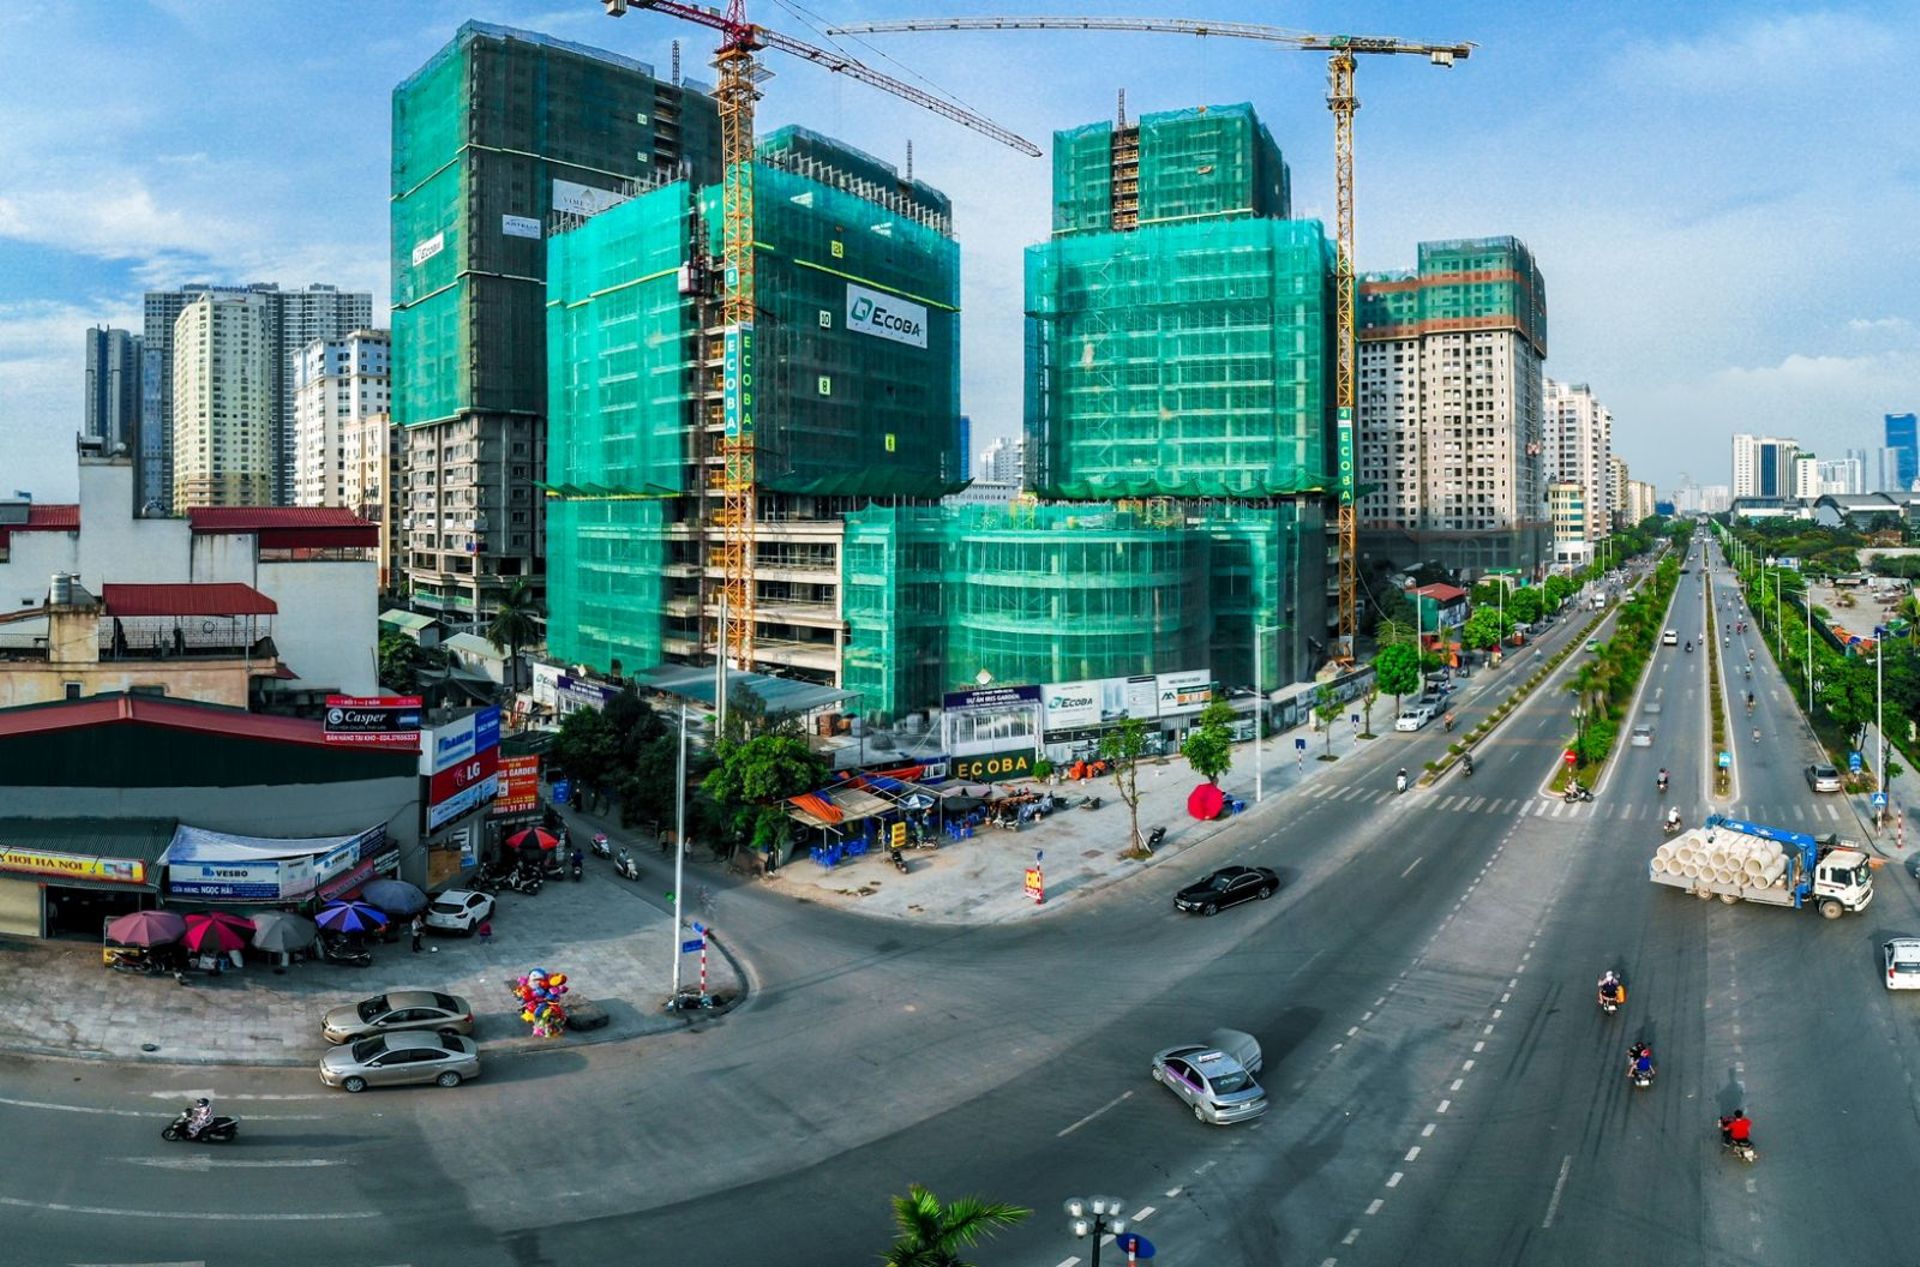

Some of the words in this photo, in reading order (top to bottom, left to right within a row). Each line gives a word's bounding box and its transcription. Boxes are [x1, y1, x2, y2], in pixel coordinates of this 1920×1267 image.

[871, 306, 921, 337] ECOBA
[726, 339, 736, 429] ECOBA
[743, 336, 752, 425] ECOBA
[1340, 432, 1350, 500] ECOBA
[1061, 697, 1093, 709] ECOBA
[345, 711, 387, 725] Casper
[467, 762, 480, 781] LG
[958, 757, 1028, 777] ECOBA
